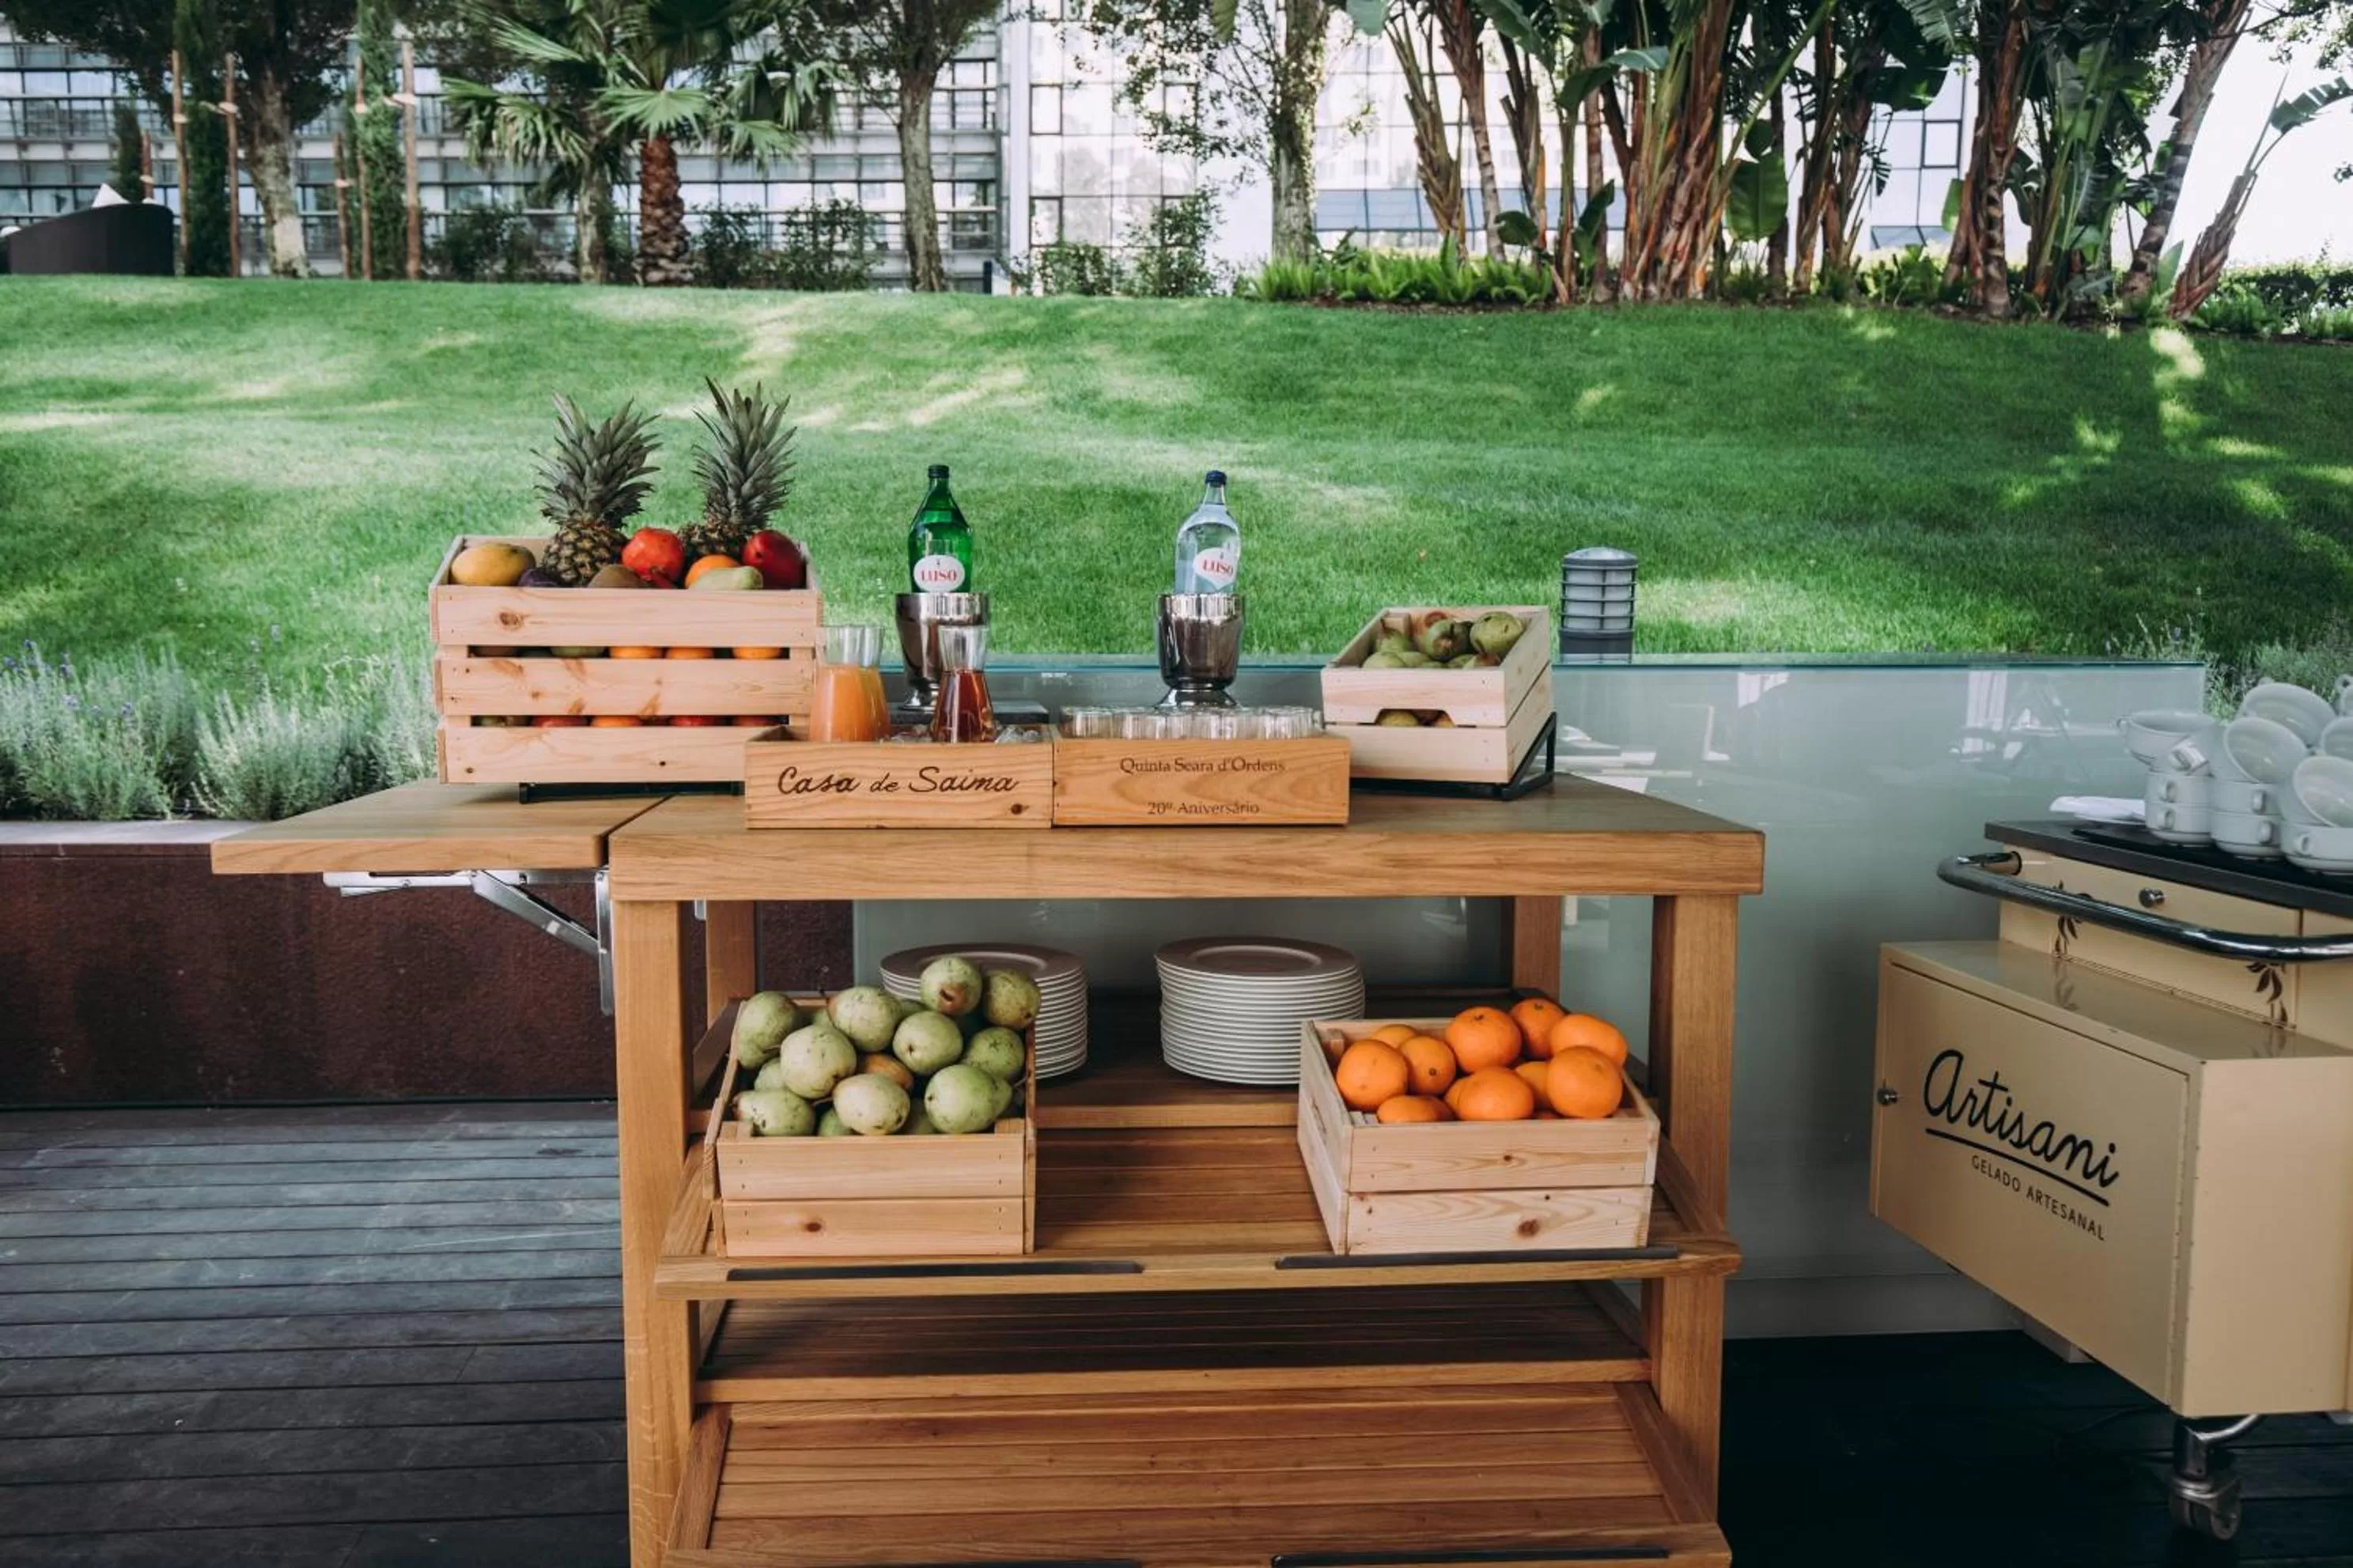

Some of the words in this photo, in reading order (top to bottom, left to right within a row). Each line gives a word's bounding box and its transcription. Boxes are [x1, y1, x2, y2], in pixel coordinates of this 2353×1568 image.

[777, 766, 861, 794] Casa
[870, 773, 899, 792] de
[909, 766, 1020, 792] Saima
[1119, 758, 1171, 774] Quinta
[1177, 801, 1260, 814] Aniversário
[1924, 1049, 2120, 1188] Artisani
[1971, 1154, 2021, 1192] GELADO
[2026, 1185, 2105, 1241] ARTESANAL
